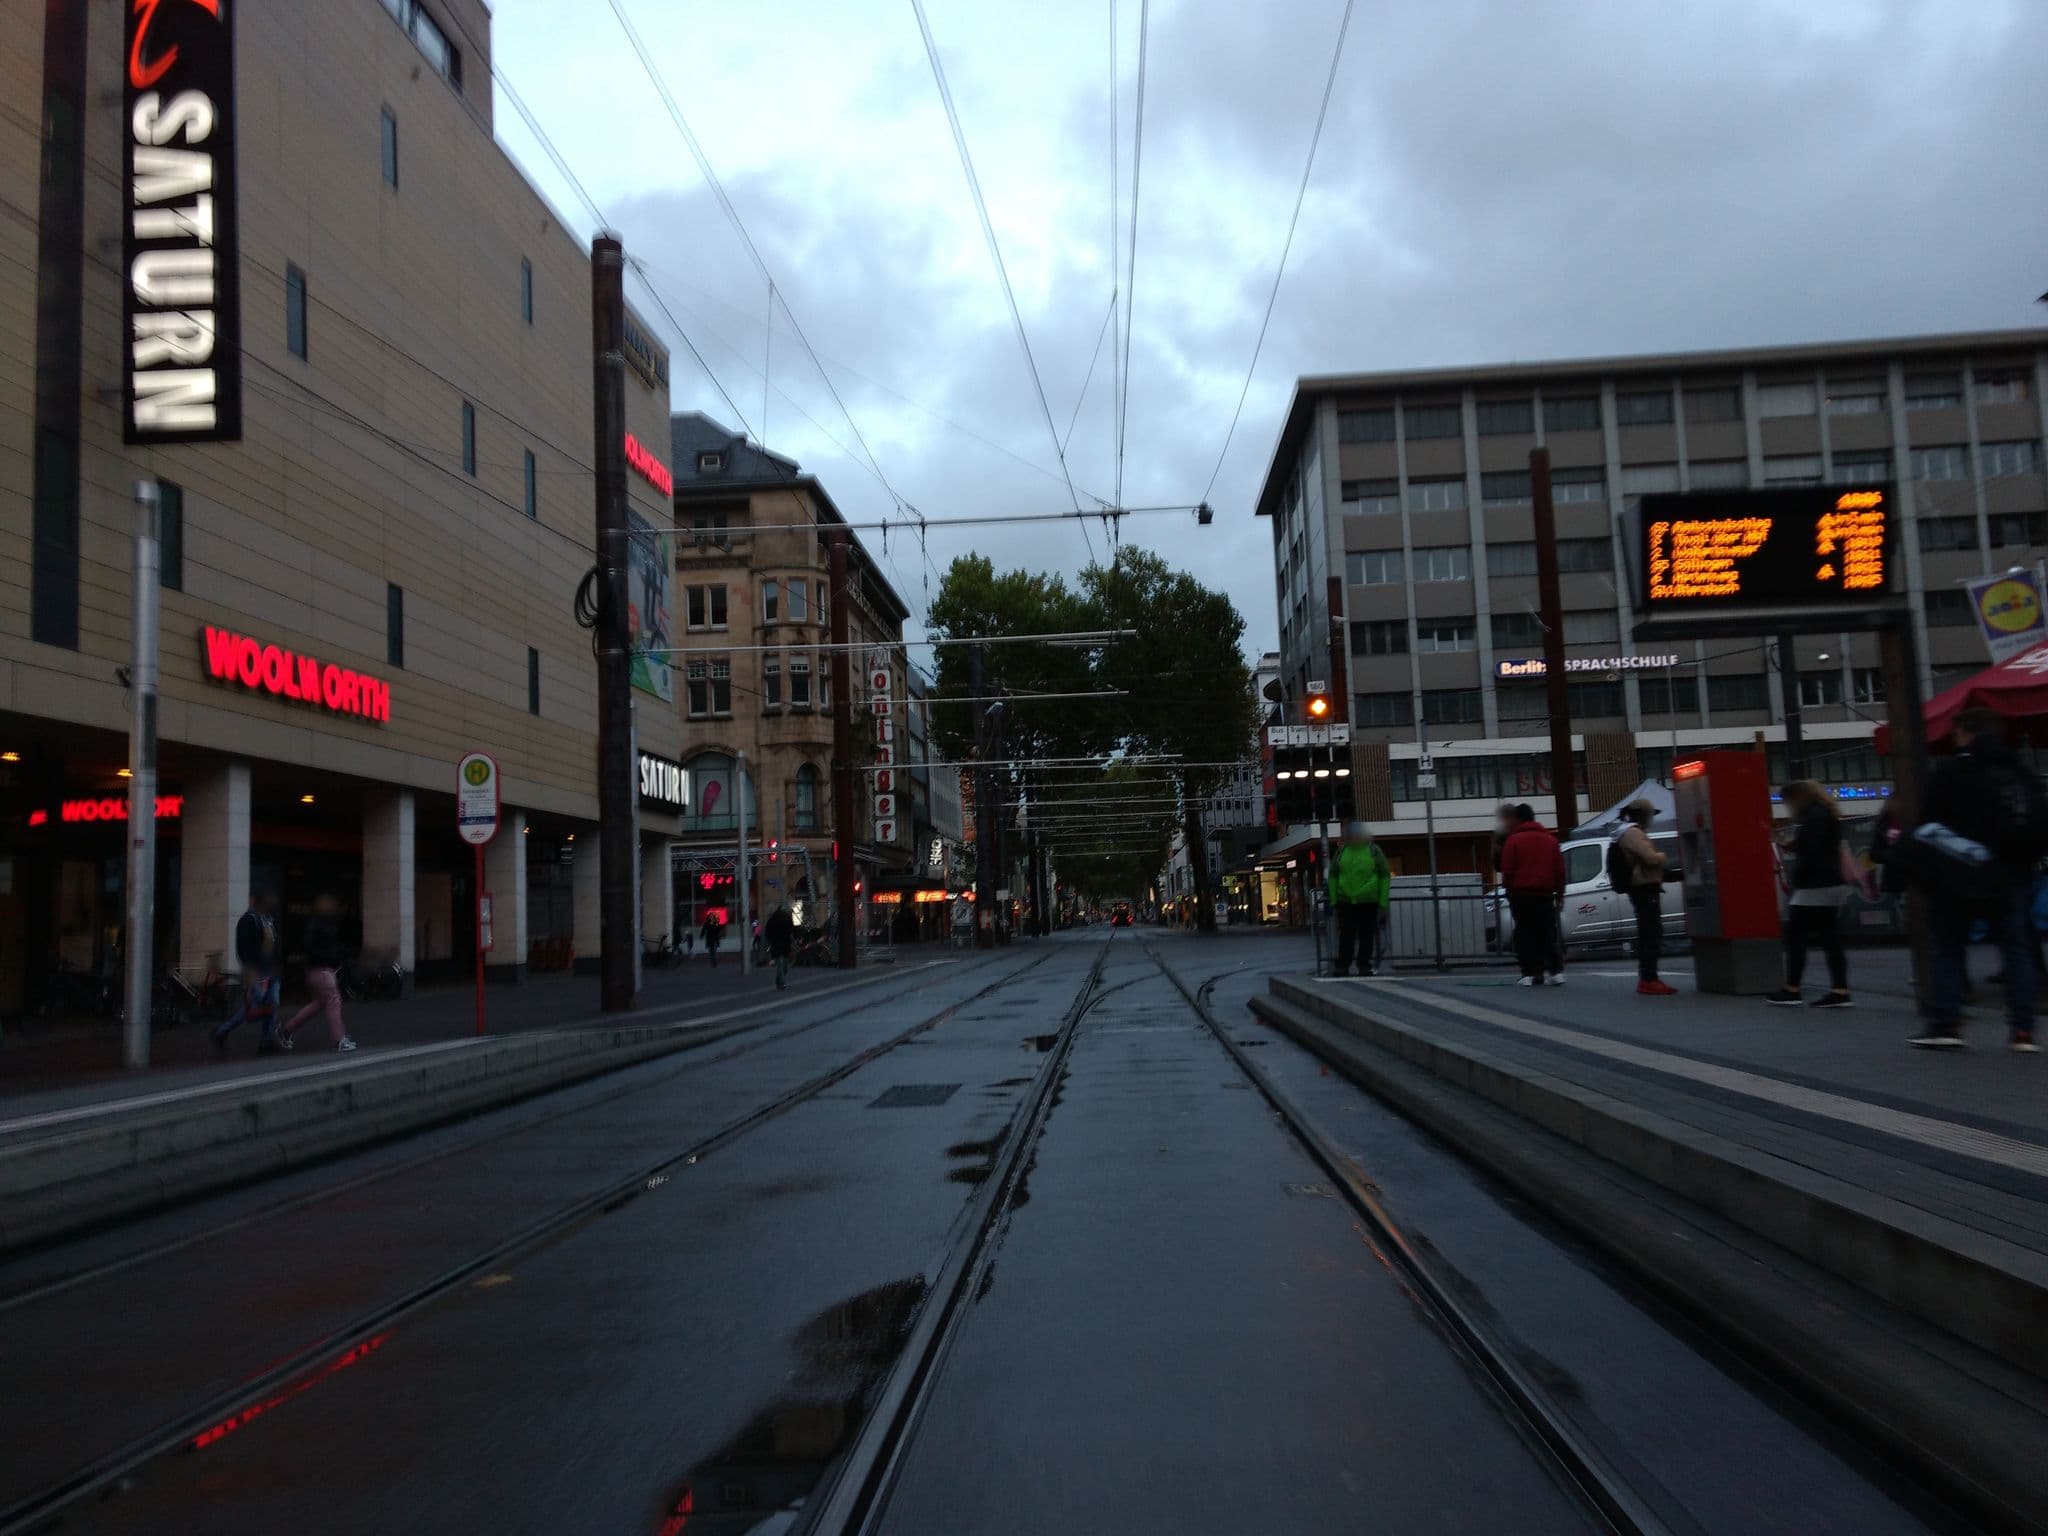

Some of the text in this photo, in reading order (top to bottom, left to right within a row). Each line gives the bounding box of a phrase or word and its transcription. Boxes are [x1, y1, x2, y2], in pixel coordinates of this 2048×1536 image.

[133, 89, 216, 433] SATURN
[625, 432, 673, 497] OLWORTH
[202, 625, 390, 722] WOOLWORTH
[1564, 654, 1679, 673] SPRACHSCHULE
[641, 754, 689, 806] SATURN
[1420, 755, 1431, 767] H
